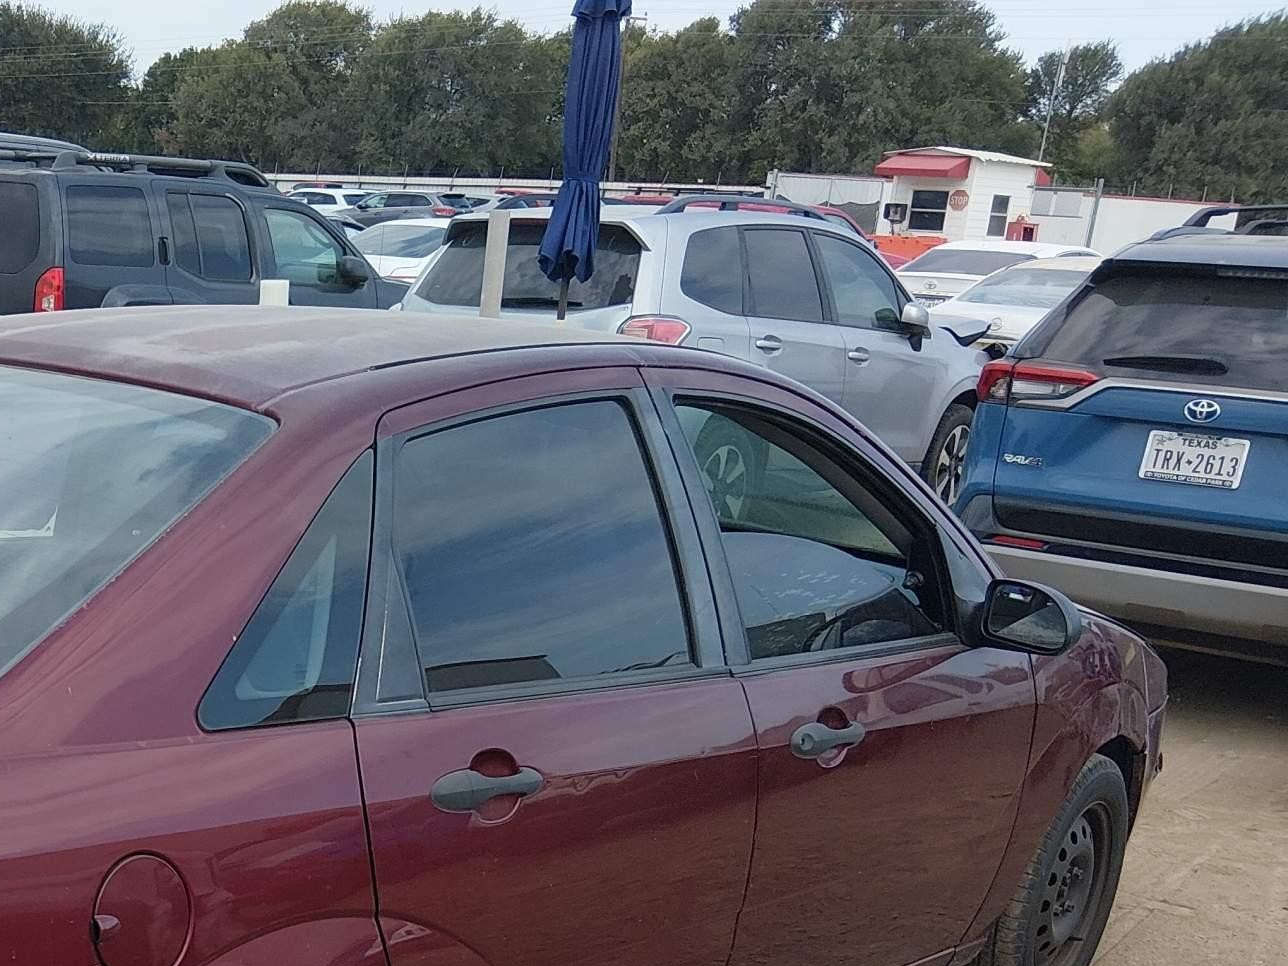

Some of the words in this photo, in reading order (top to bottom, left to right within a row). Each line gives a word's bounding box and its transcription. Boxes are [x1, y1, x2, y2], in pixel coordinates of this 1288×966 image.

[950, 195, 968, 206] STOP
[1181, 438, 1218, 450] TEXAS
[1003, 453, 1042, 466] RAV4
[1153, 472, 1178, 481] TOYOTA
[1206, 478, 1224, 487] PARK
